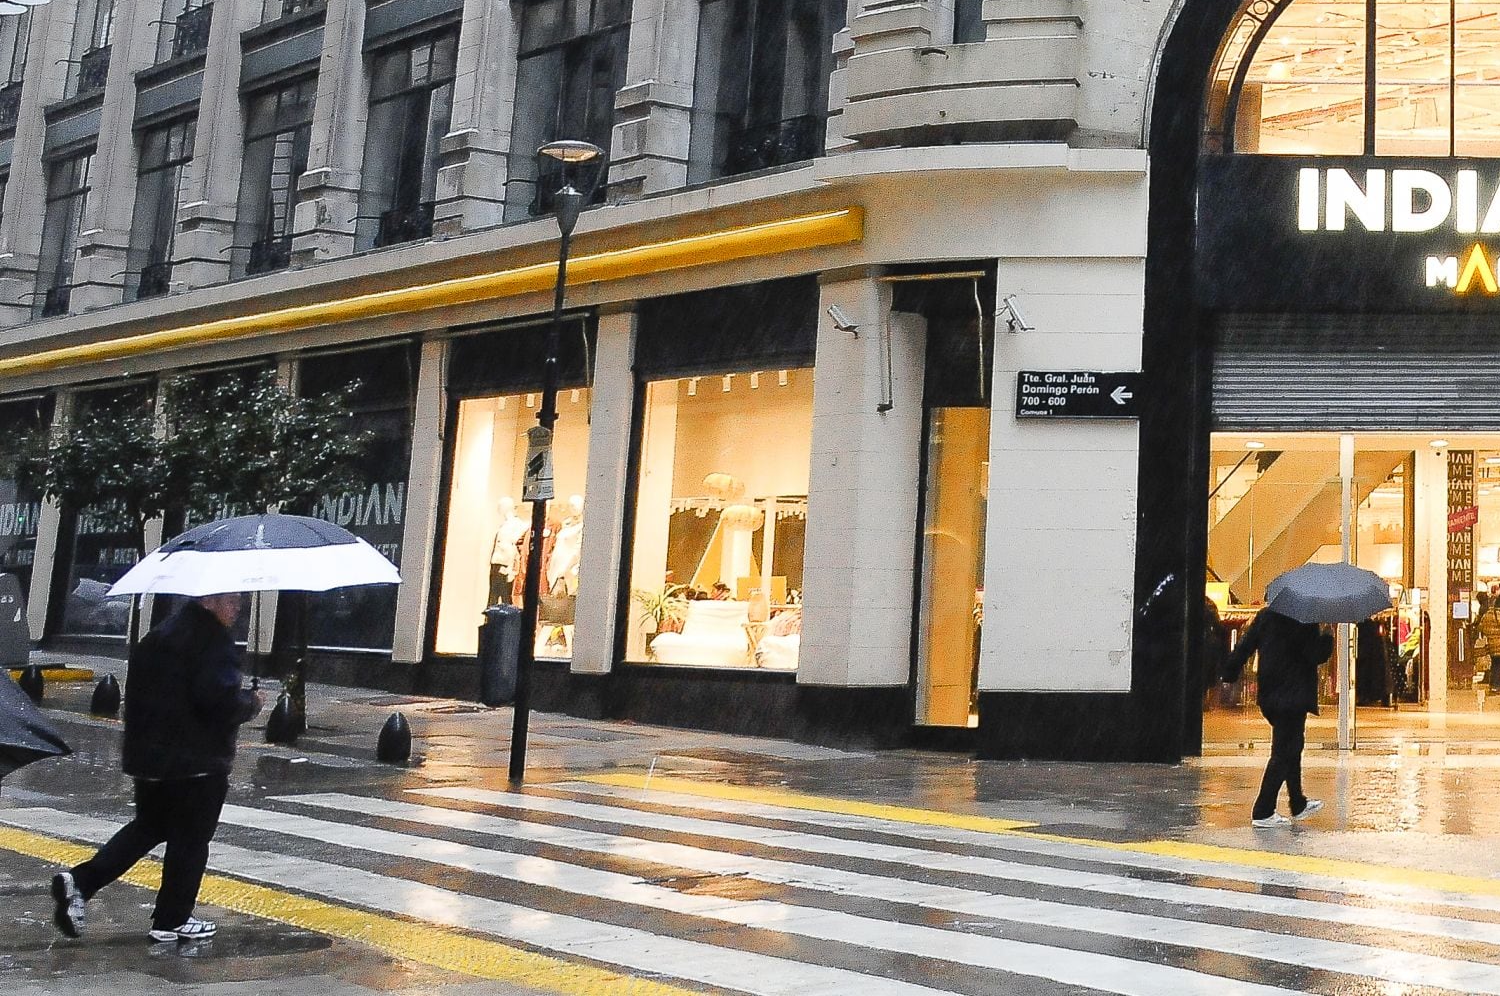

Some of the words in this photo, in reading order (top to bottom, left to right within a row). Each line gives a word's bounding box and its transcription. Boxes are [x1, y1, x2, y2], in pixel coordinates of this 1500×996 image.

[1023, 373, 1042, 383] Tte.
[1044, 373, 1068, 384] Gral.
[1070, 373, 1096, 384] Juan
[1022, 384, 1068, 395] Domingo
[1070, 384, 1100, 395] Perón
[1022, 396, 1040, 406] 700
[1047, 396, 1066, 406] 600
